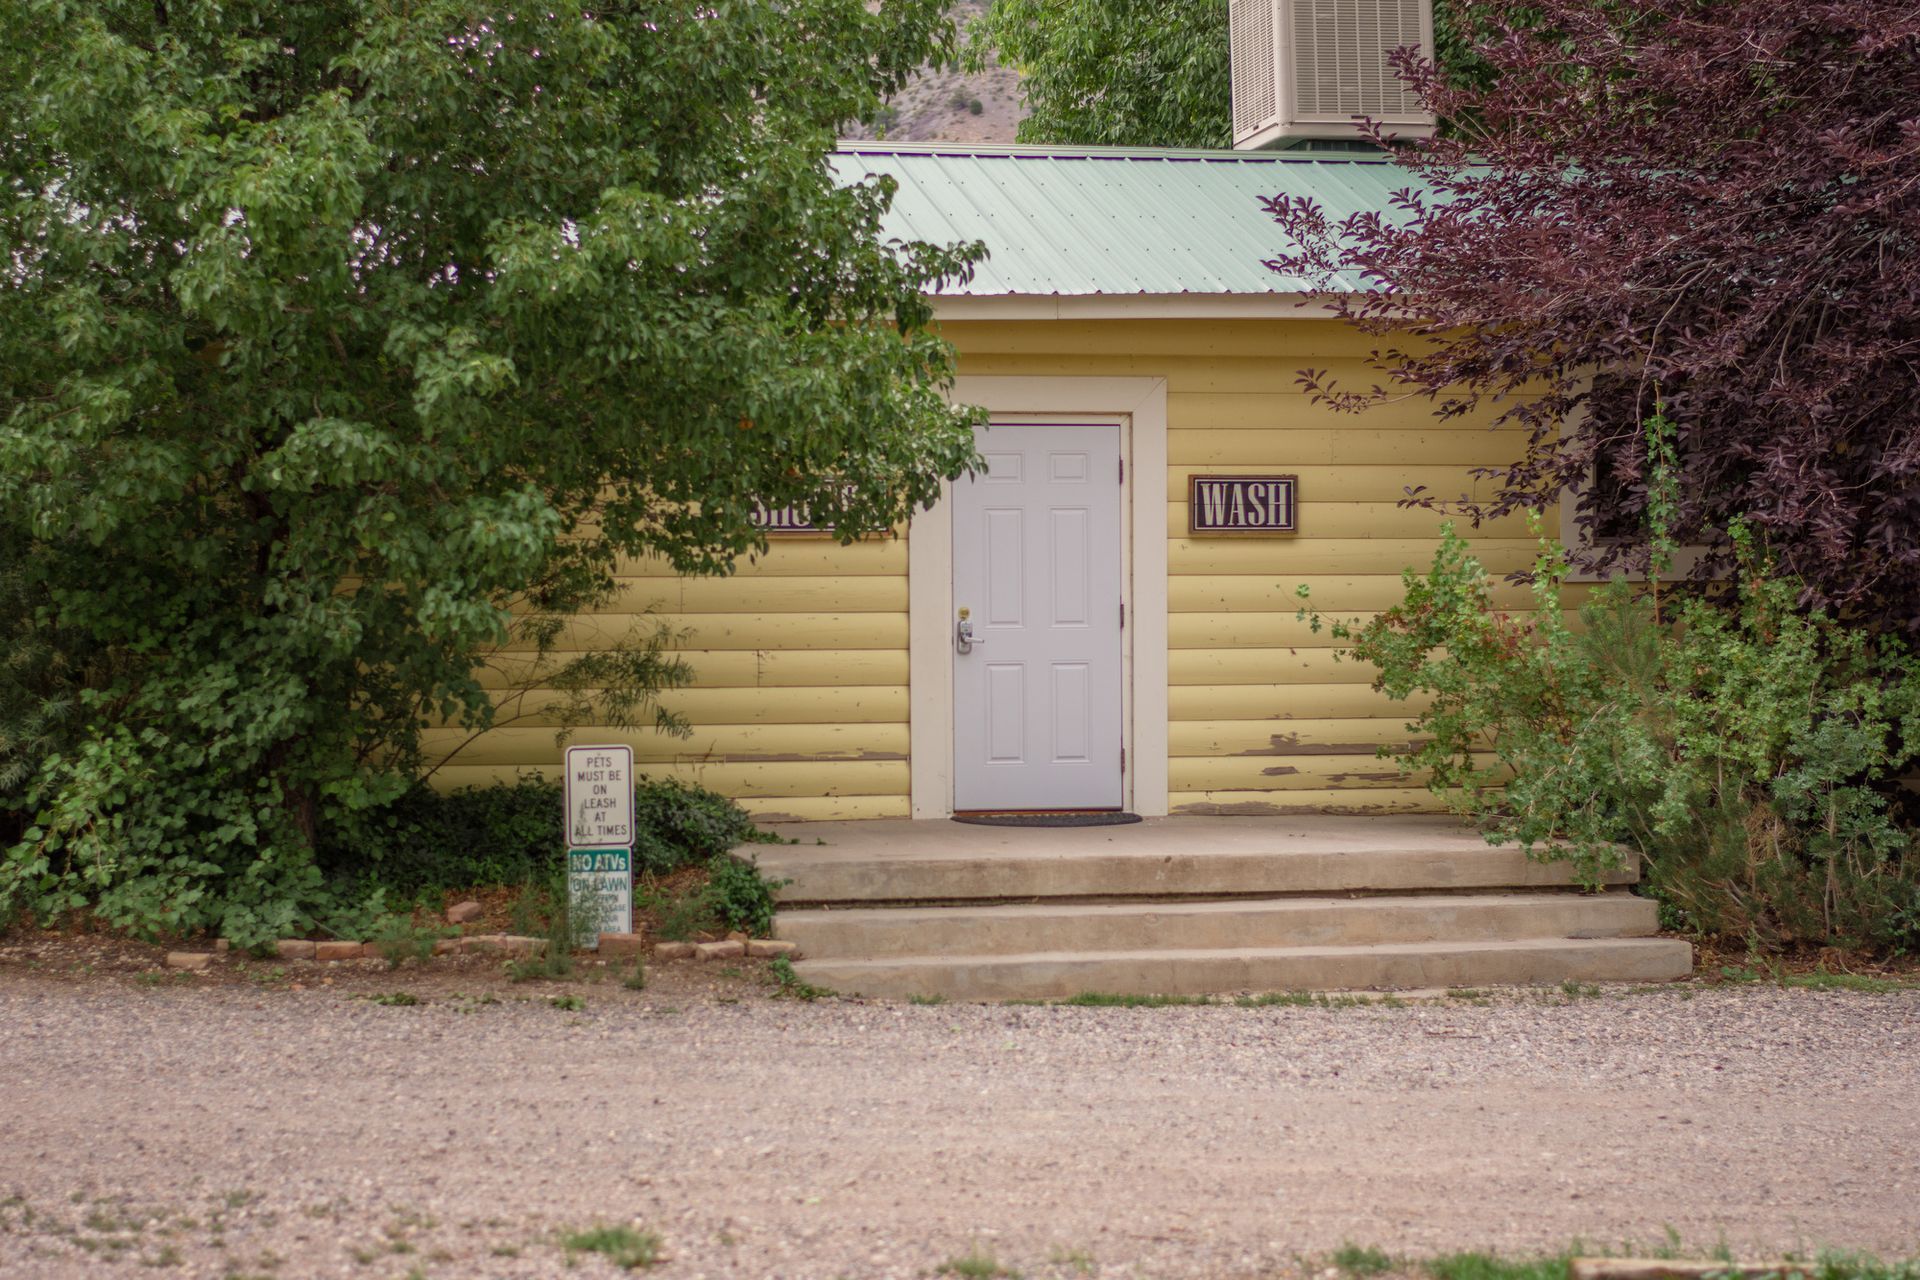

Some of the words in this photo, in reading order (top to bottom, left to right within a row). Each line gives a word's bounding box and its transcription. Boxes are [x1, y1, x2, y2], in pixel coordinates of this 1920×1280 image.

[1200, 483, 1288, 526] WASH
[586, 756, 612, 768] PETS
[577, 771, 605, 782] MUST
[608, 770, 622, 781] BE
[592, 784, 607, 795] ON
[584, 797, 617, 809] LEASH
[594, 811, 606, 822] AT
[575, 825, 594, 837] ALL
[597, 824, 627, 836] TIMES
[572, 854, 592, 871] NO
[594, 853, 626, 871] ATVs
[573, 878, 590, 892] ON
[594, 877, 627, 892] LAWN
